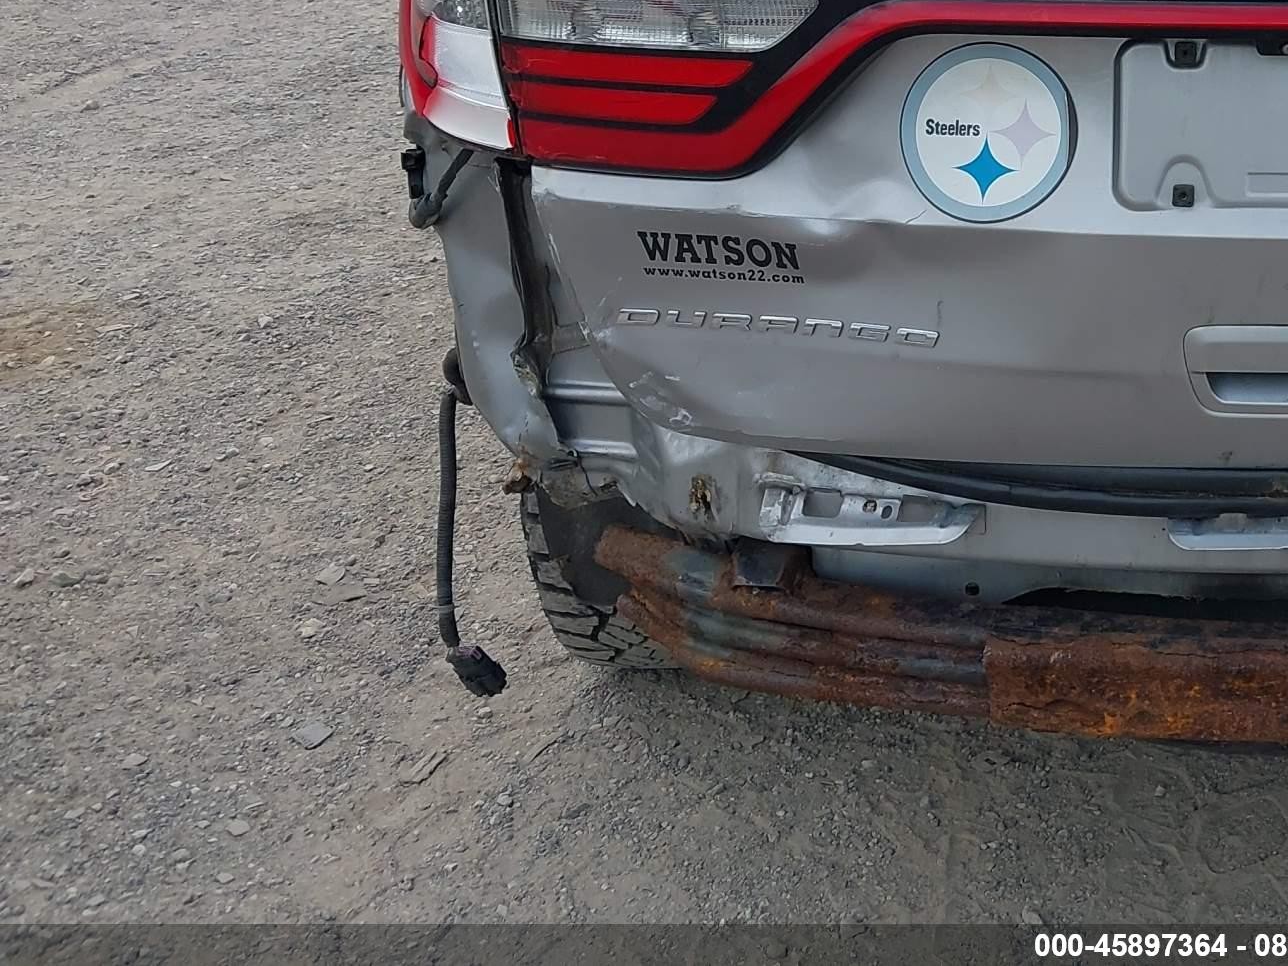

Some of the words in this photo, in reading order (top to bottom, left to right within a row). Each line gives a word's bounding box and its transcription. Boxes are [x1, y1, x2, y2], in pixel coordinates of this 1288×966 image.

[925, 118, 981, 136] Steelers
[637, 231, 800, 270] WATSON
[643, 267, 805, 284] www.watson22.com
[616, 308, 940, 349] DURANGO
